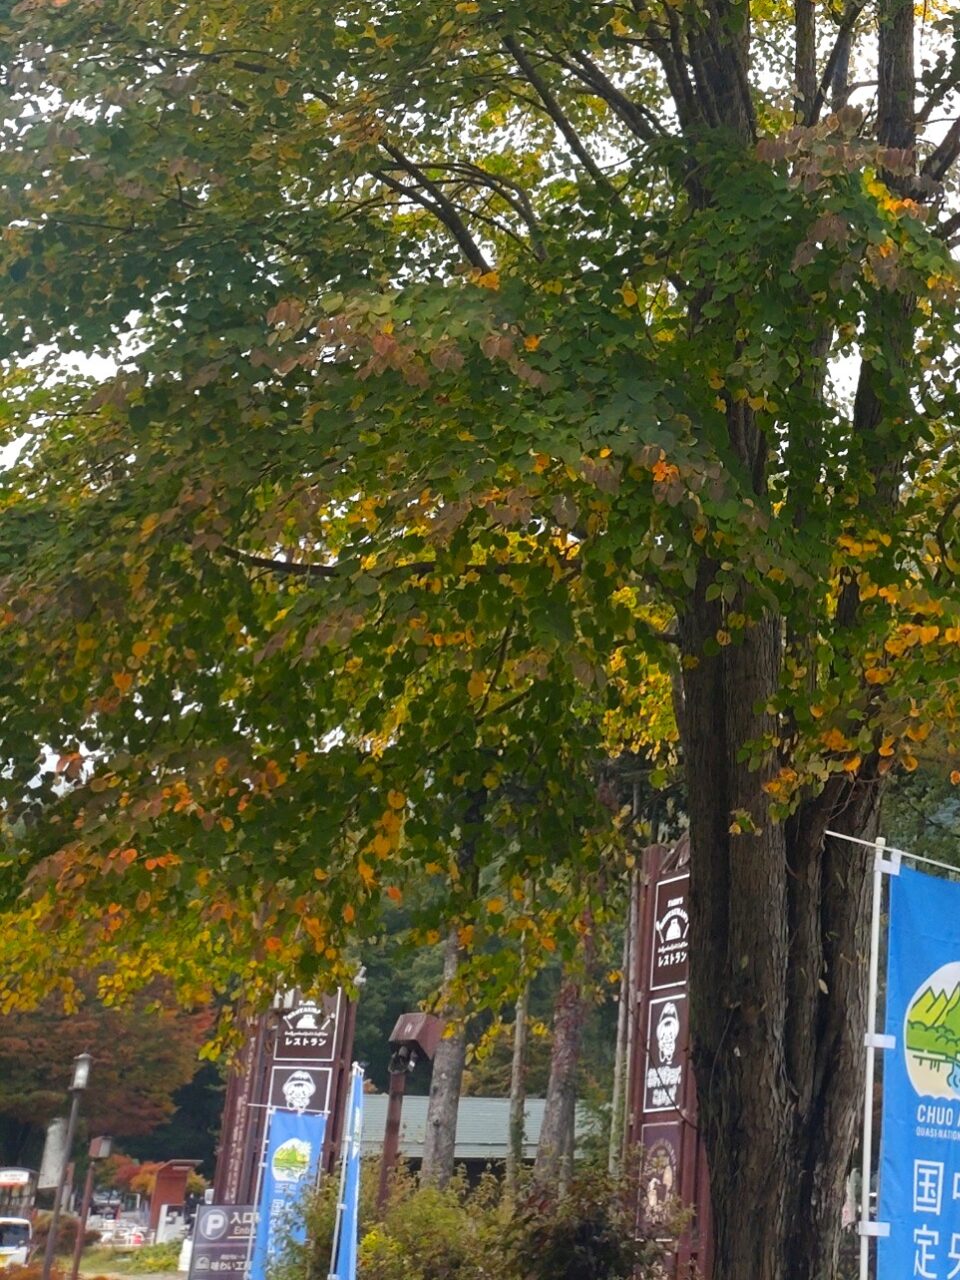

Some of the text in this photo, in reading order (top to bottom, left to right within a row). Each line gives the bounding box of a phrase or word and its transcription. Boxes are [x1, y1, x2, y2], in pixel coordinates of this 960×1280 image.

[658, 951, 687, 968] レストラン
[285, 1037, 327, 1046] レストラン
[917, 1104, 954, 1126] CHUO
[206, 1214, 224, 1235] P
[913, 1159, 944, 1279] 国定
